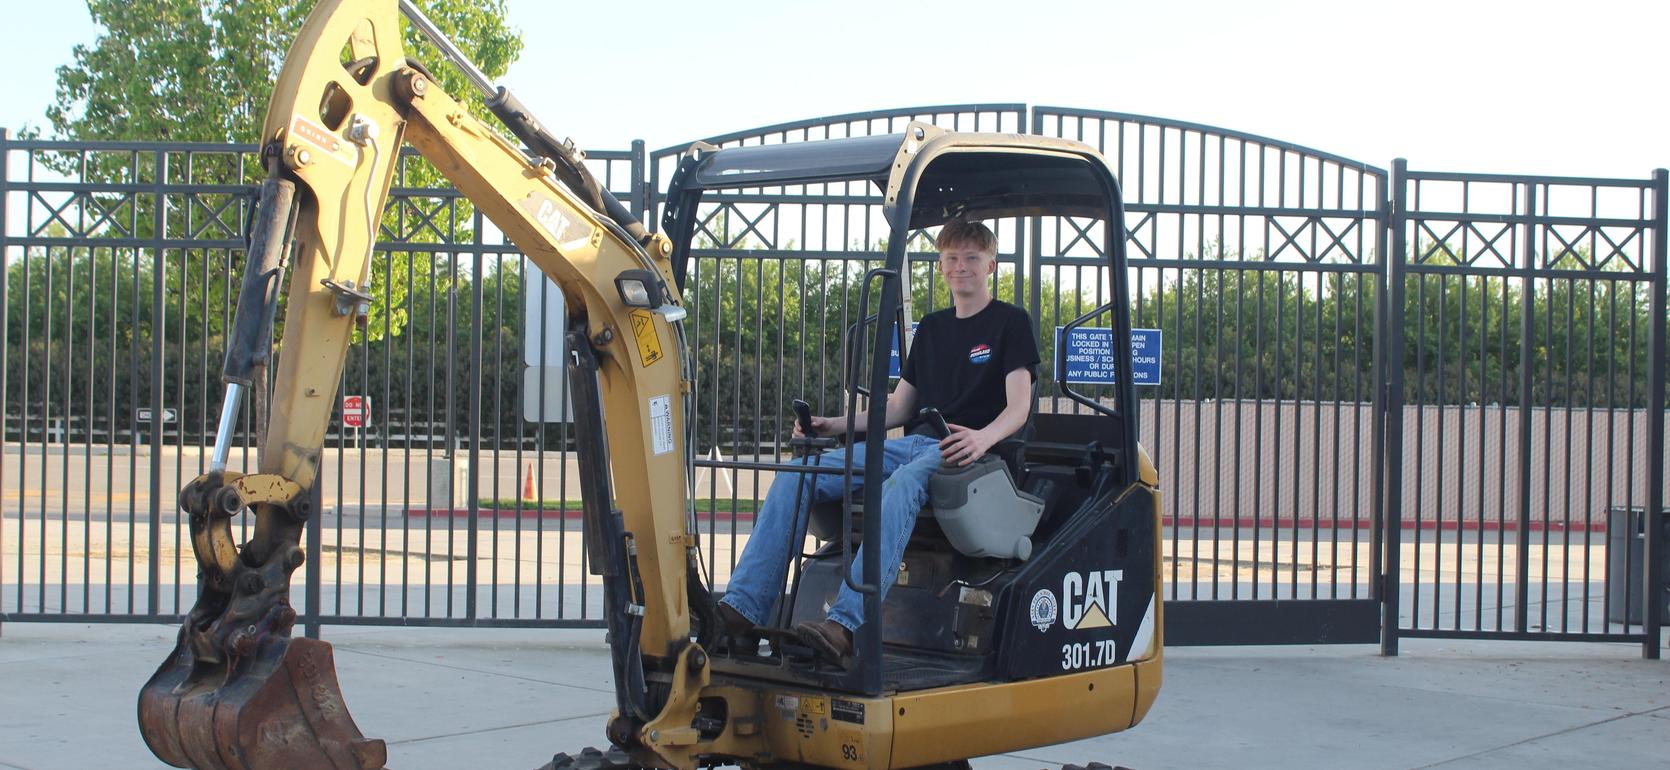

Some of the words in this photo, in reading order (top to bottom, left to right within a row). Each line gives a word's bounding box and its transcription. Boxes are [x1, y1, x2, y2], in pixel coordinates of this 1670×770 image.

[537, 199, 570, 240] CAT
[1062, 569, 1123, 629] CAT
[1062, 639, 1115, 670] 301.7D
[842, 745, 857, 761] 93
